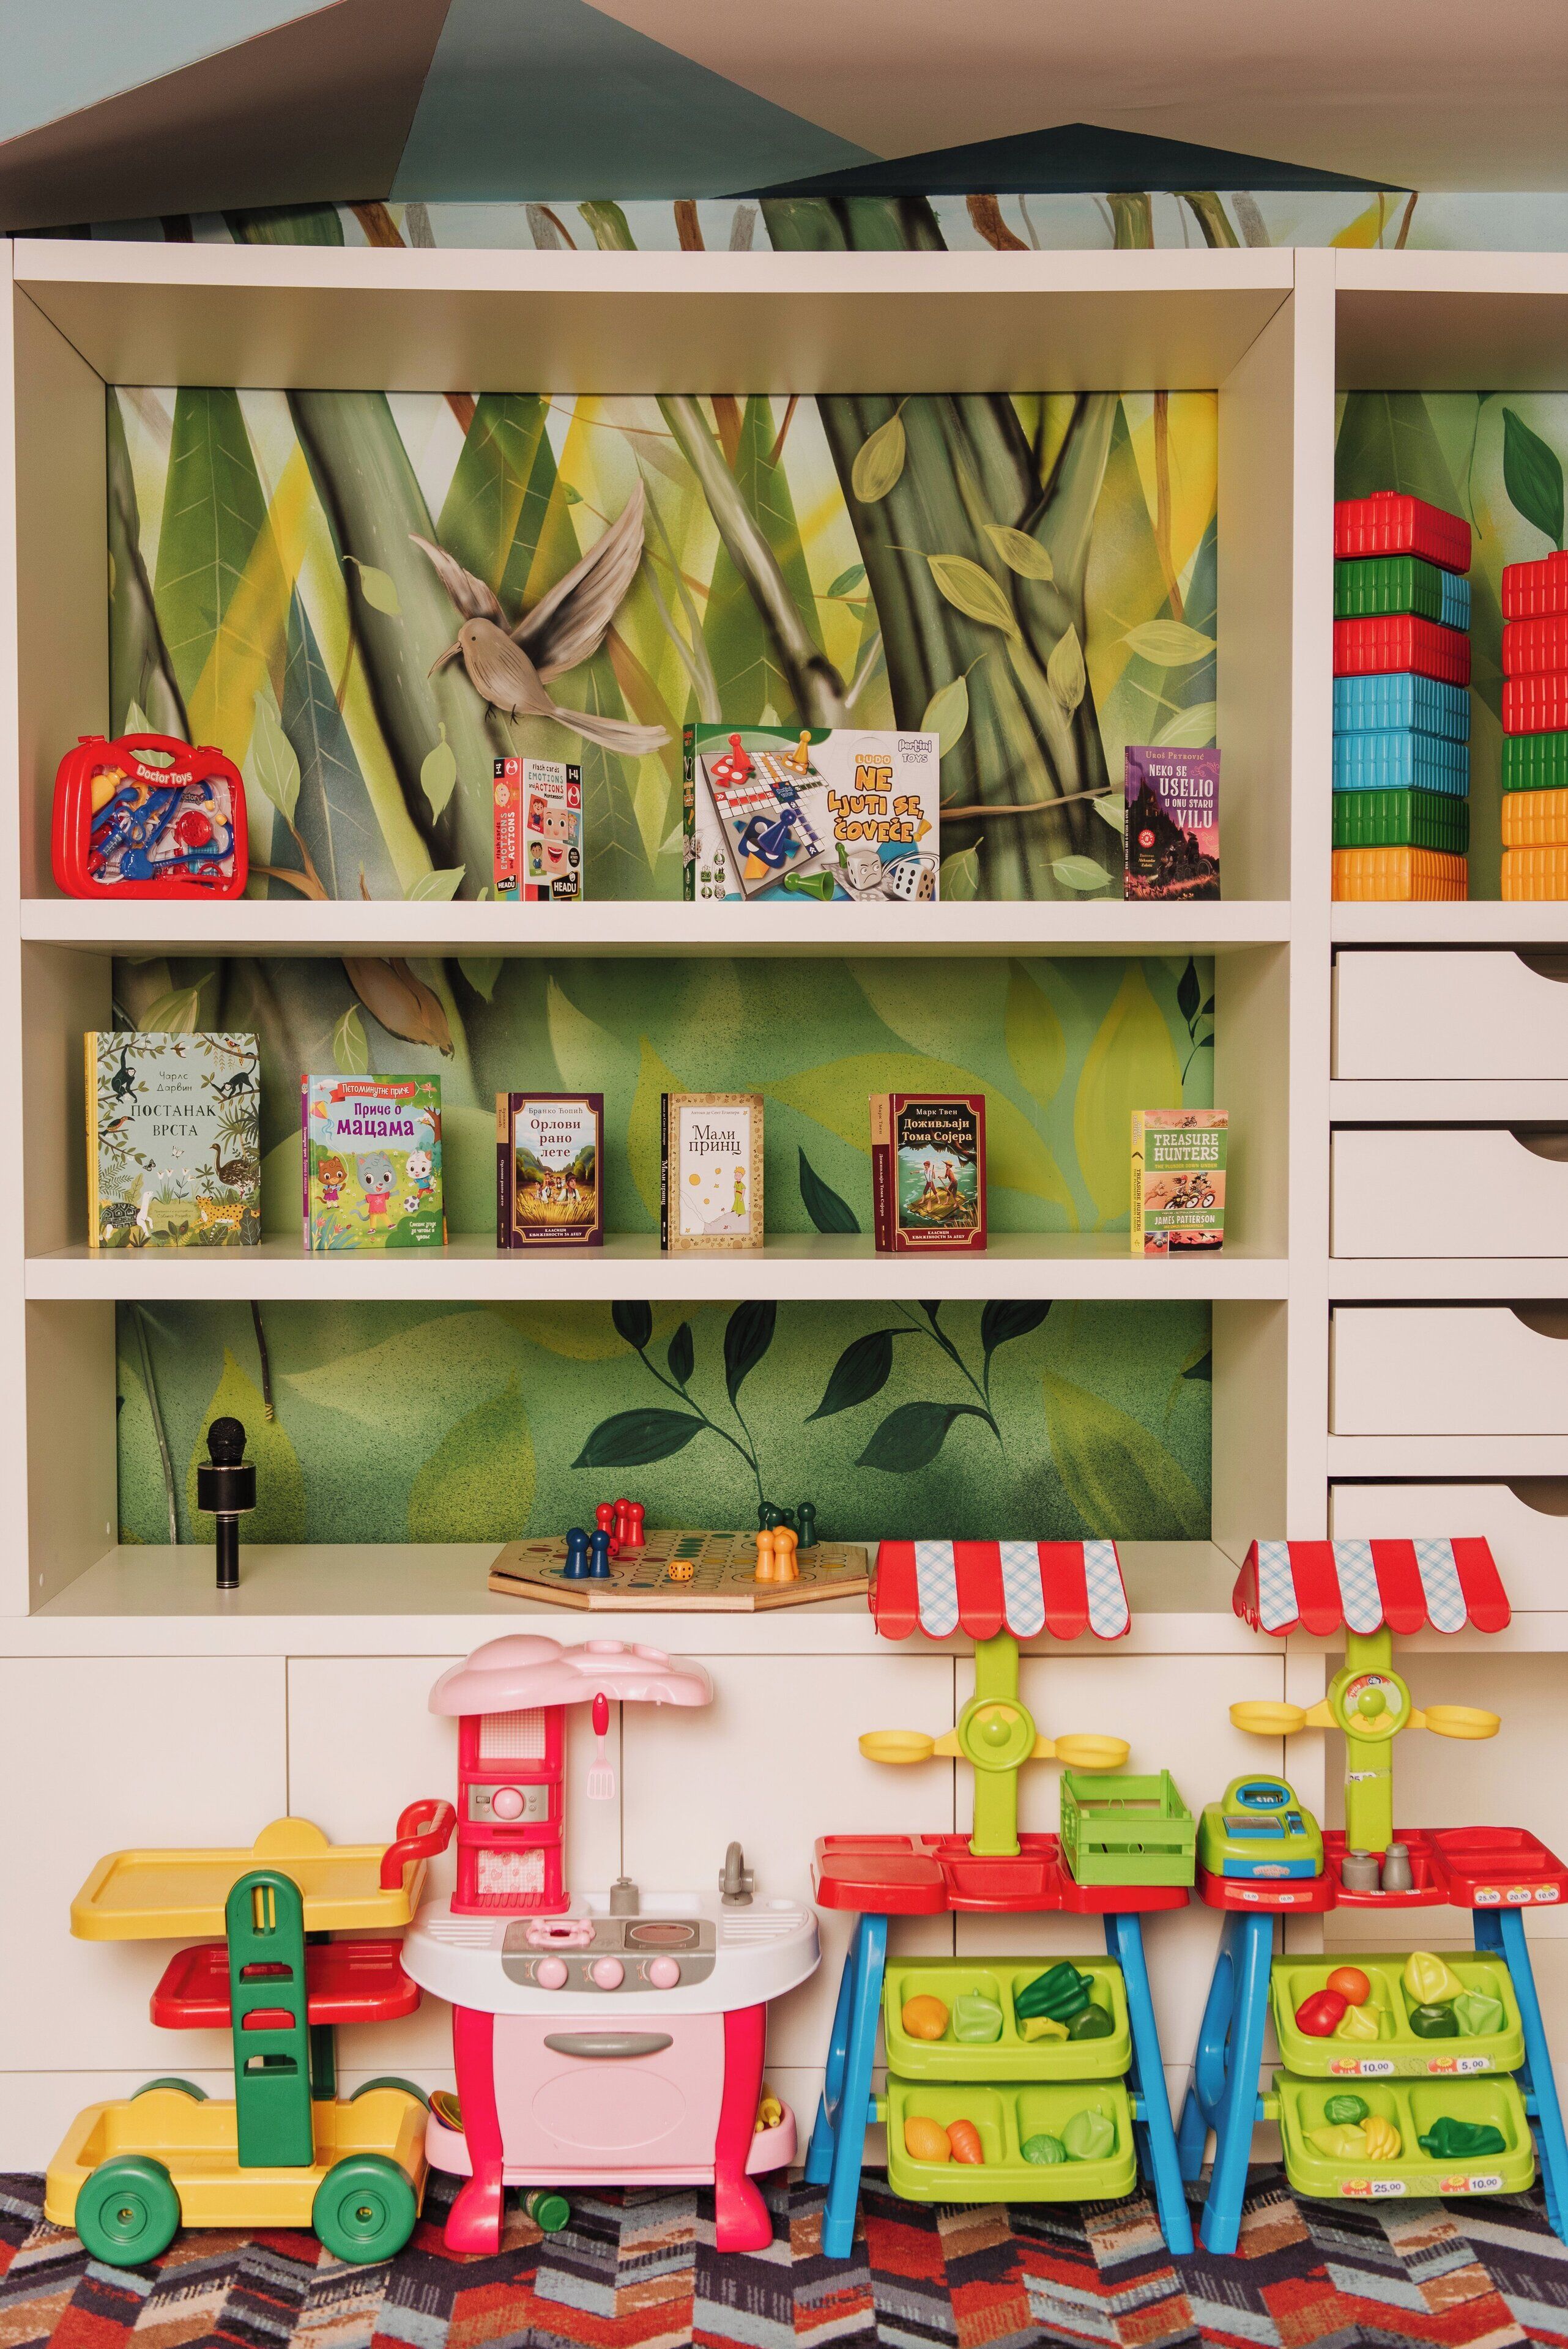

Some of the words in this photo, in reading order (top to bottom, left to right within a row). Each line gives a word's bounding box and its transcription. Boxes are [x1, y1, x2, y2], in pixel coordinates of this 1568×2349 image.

[856, 755, 891, 764] LUDO
[902, 754, 928, 763] TOYS
[136, 763, 170, 784] Doctor
[170, 771, 193, 785] Toys
[1149, 764, 1173, 777] NEKO
[1176, 765, 1187, 777] SE
[529, 772, 563, 784] EMOTIONS
[855, 765, 893, 792] NE
[535, 782, 563, 794] ACTIONS
[1159, 779, 1214, 798] USELIO
[828, 790, 887, 818] LJUTI
[893, 795, 924, 819] SE,
[1165, 798, 1170, 807] U
[1172, 798, 1186, 807] ONU
[1189, 799, 1213, 809] STARU
[1176, 809, 1213, 828] VILU
[497, 880, 515, 889] HEADU
[554, 882, 576, 892] HEADU
[159, 1071, 188, 1082] Чарлс
[157, 1082, 192, 1092] Дарвин
[342, 1083, 389, 1097] Петоминутне
[390, 1086, 410, 1097] приче
[131, 1104, 217, 1117] ПОСТАНАК
[354, 1103, 391, 1118] Приче
[395, 1105, 401, 1115] о
[152, 1124, 198, 1136] ВРСТА
[530, 1119, 581, 1132] Орлови
[904, 1118, 969, 1131] Доживљаји
[693, 1125, 735, 1140] Мали
[902, 1132, 931, 1141] Тома
[934, 1132, 972, 1143] Сојера
[540, 1135, 572, 1146] рано
[1154, 1134, 1219, 1146] TREASURE
[540, 1148, 570, 1157] лете
[689, 1141, 742, 1156] принц
[1154, 1147, 1219, 1161] HUNTERS
[1154, 1215, 1175, 1225] JAMES
[1176, 1215, 1215, 1223] PATTERSON
[1363, 2063, 1389, 2072] 10.00
[1462, 2061, 1484, 2070] 5.00
[1374, 2183, 1401, 2192] 25.00
[1473, 2179, 1497, 2189] 10.00
